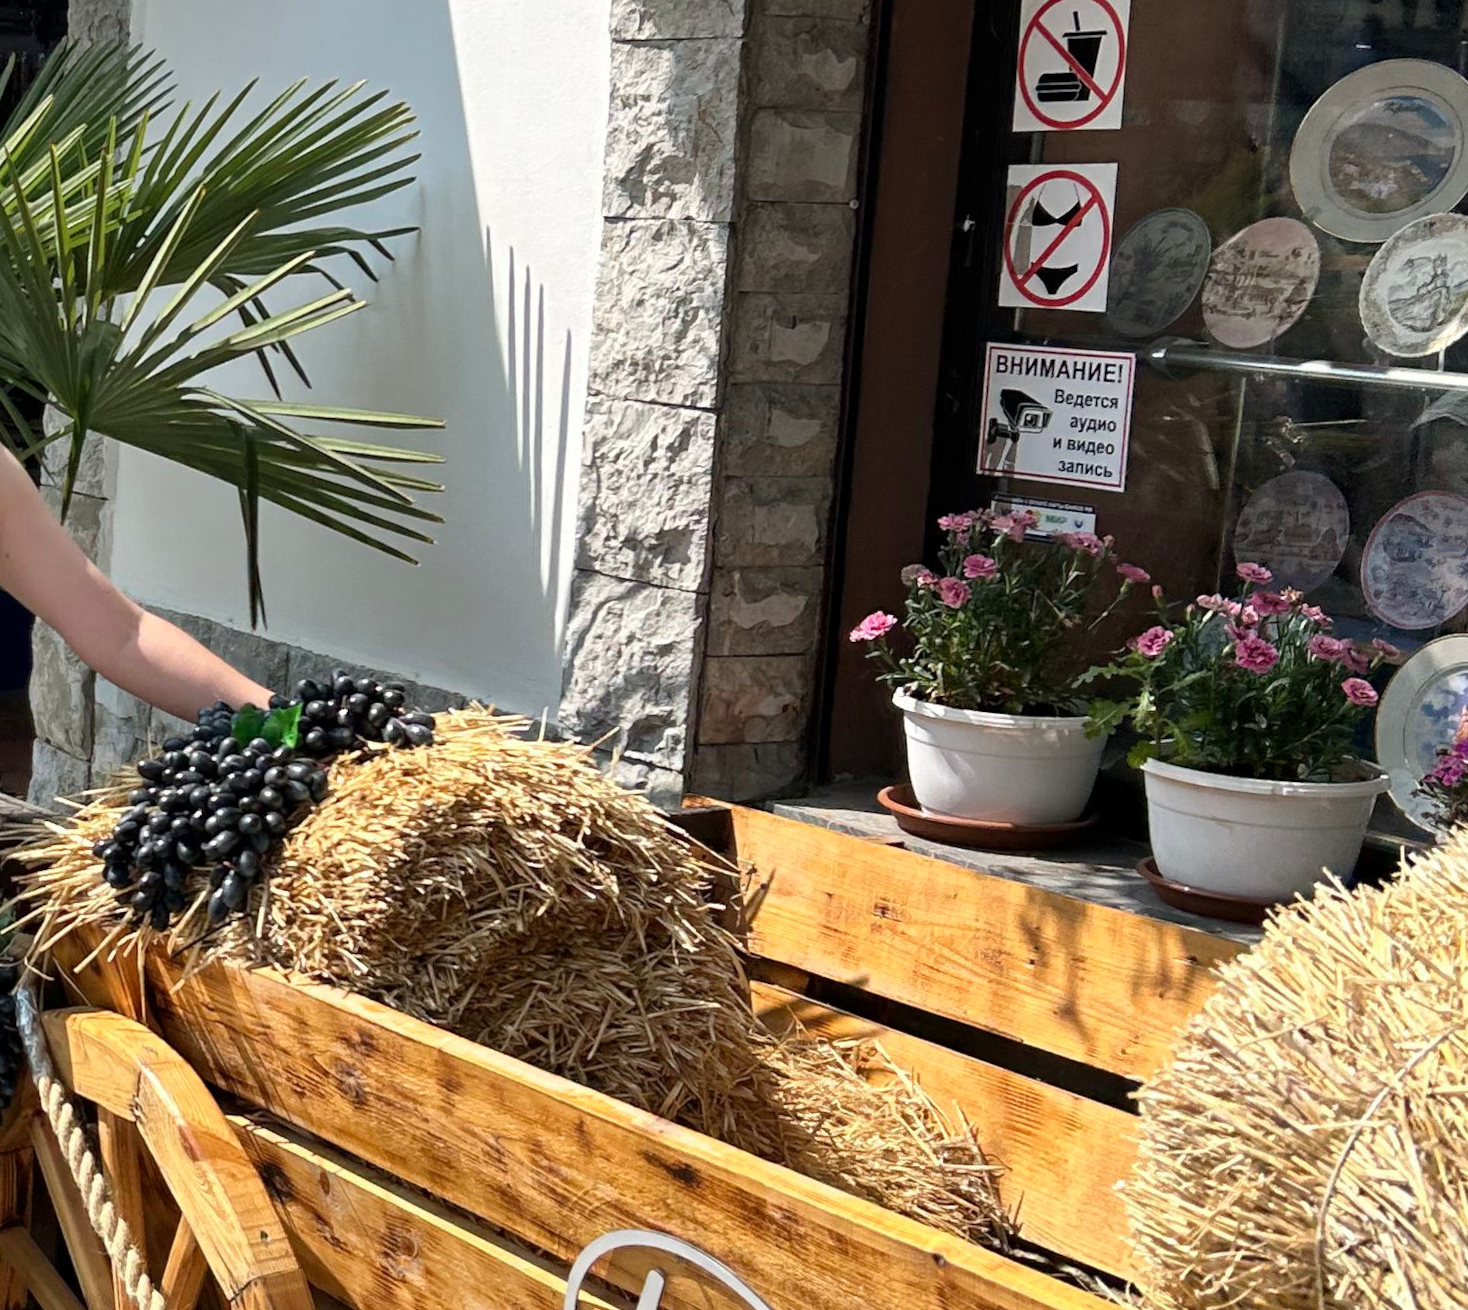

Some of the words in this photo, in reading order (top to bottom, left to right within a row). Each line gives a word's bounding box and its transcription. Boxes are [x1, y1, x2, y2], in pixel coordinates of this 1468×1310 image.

[996, 355, 1124, 383] ВНИМАНИЕ!
[1054, 388, 1119, 409] Ведется
[1069, 416, 1117, 433] аудио
[1052, 437, 1062, 449] и
[1066, 439, 1115, 456] видео
[1058, 460, 1114, 478] запись
